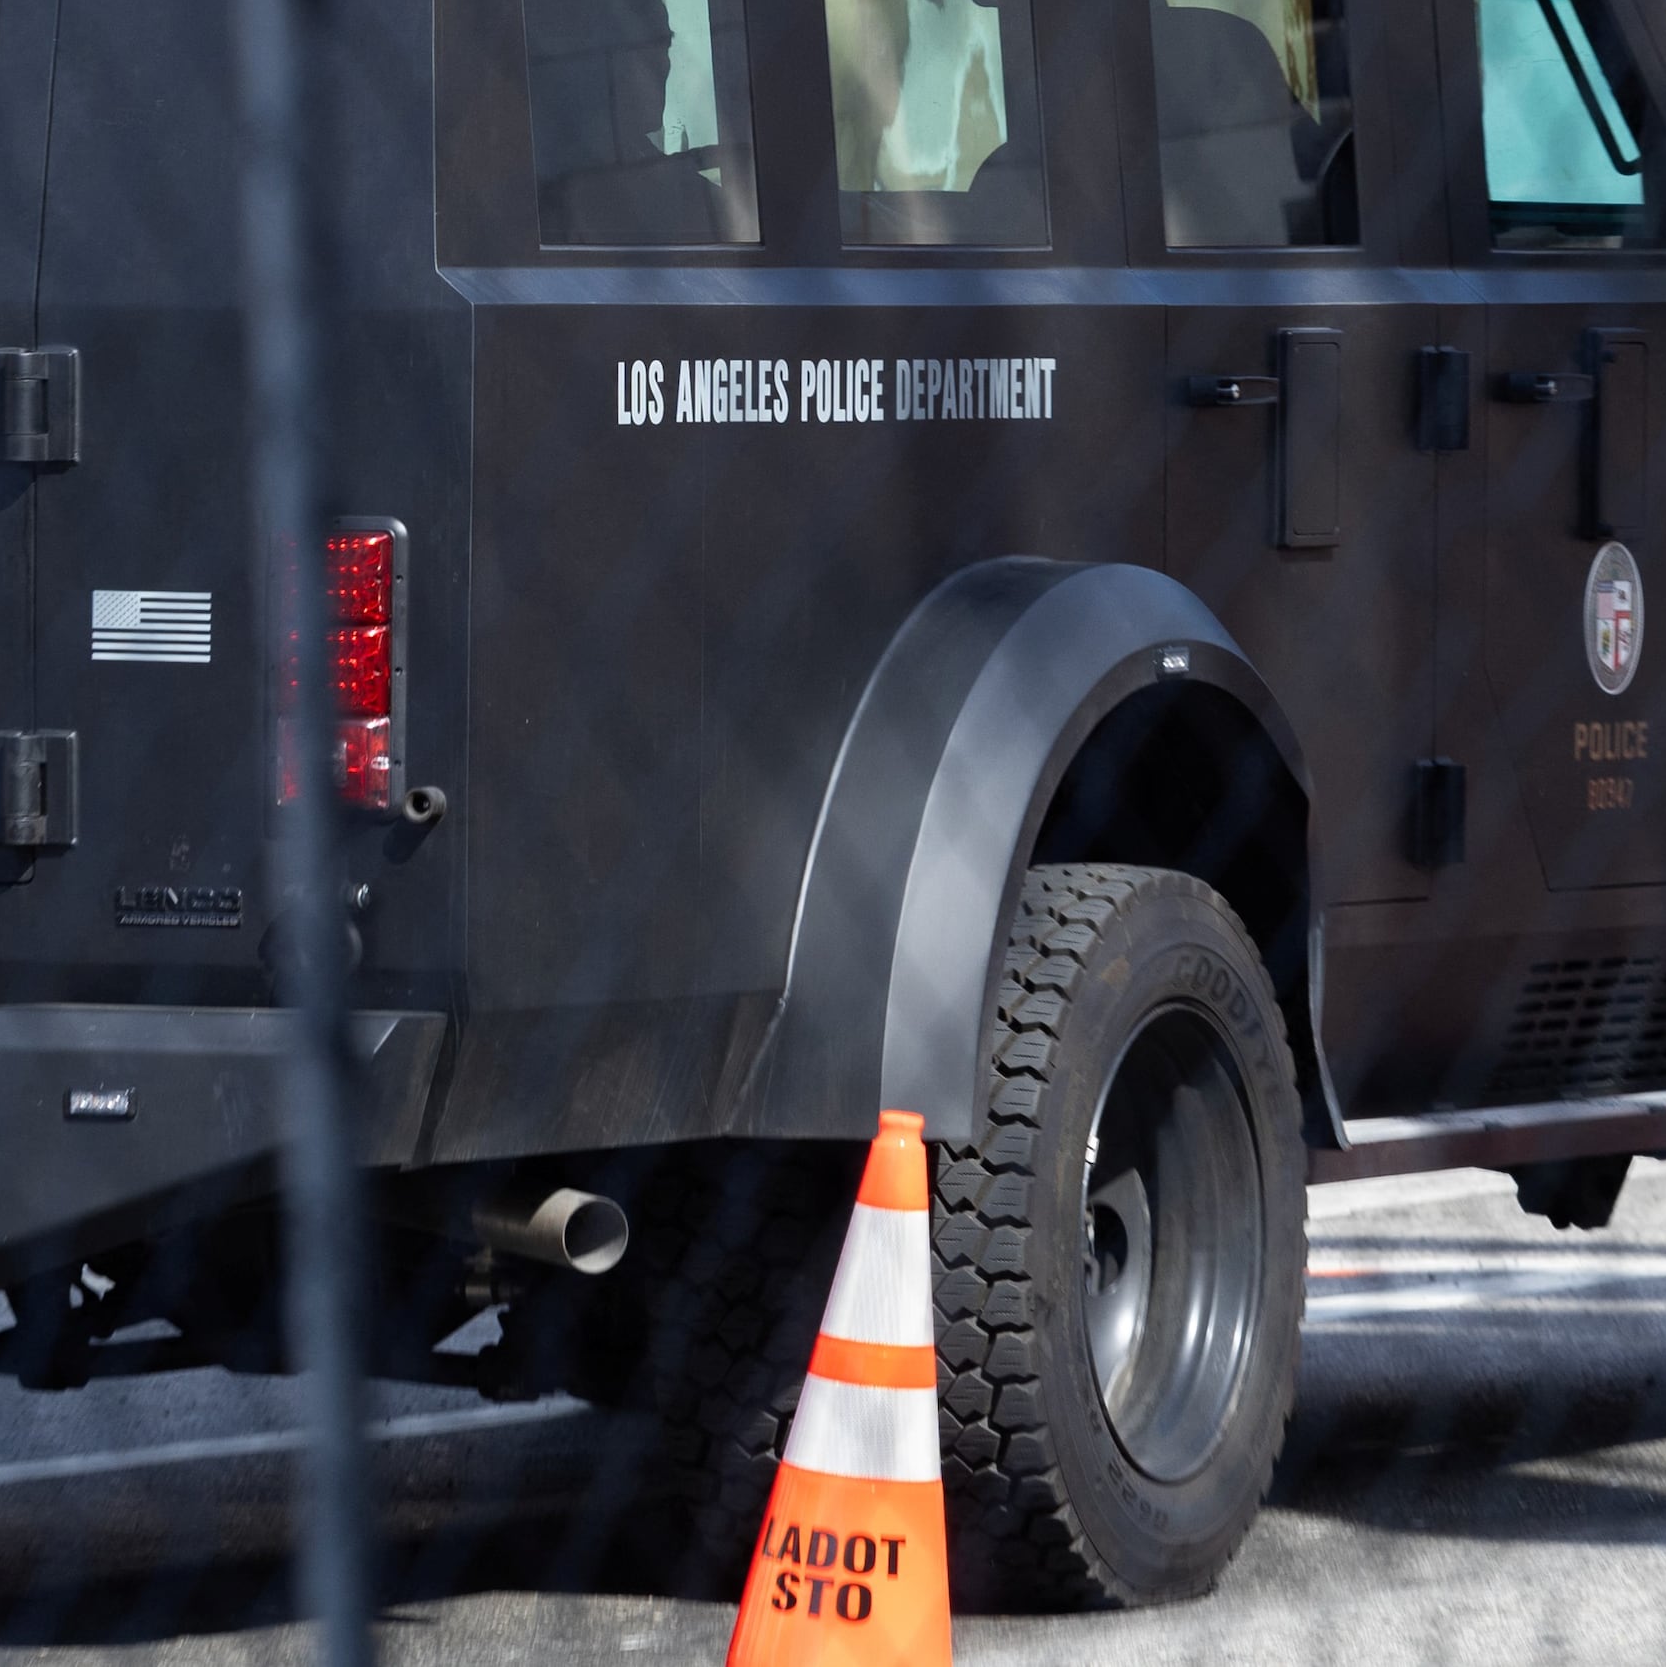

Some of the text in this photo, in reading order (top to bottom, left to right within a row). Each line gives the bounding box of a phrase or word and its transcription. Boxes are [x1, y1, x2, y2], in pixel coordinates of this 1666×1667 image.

[618, 357, 1056, 426] LOS ANGELES POLICE DEPARTMENT
[1573, 720, 1648, 761] POLICE
[763, 1517, 906, 1578] LADOT
[771, 1572, 873, 1622] STO
